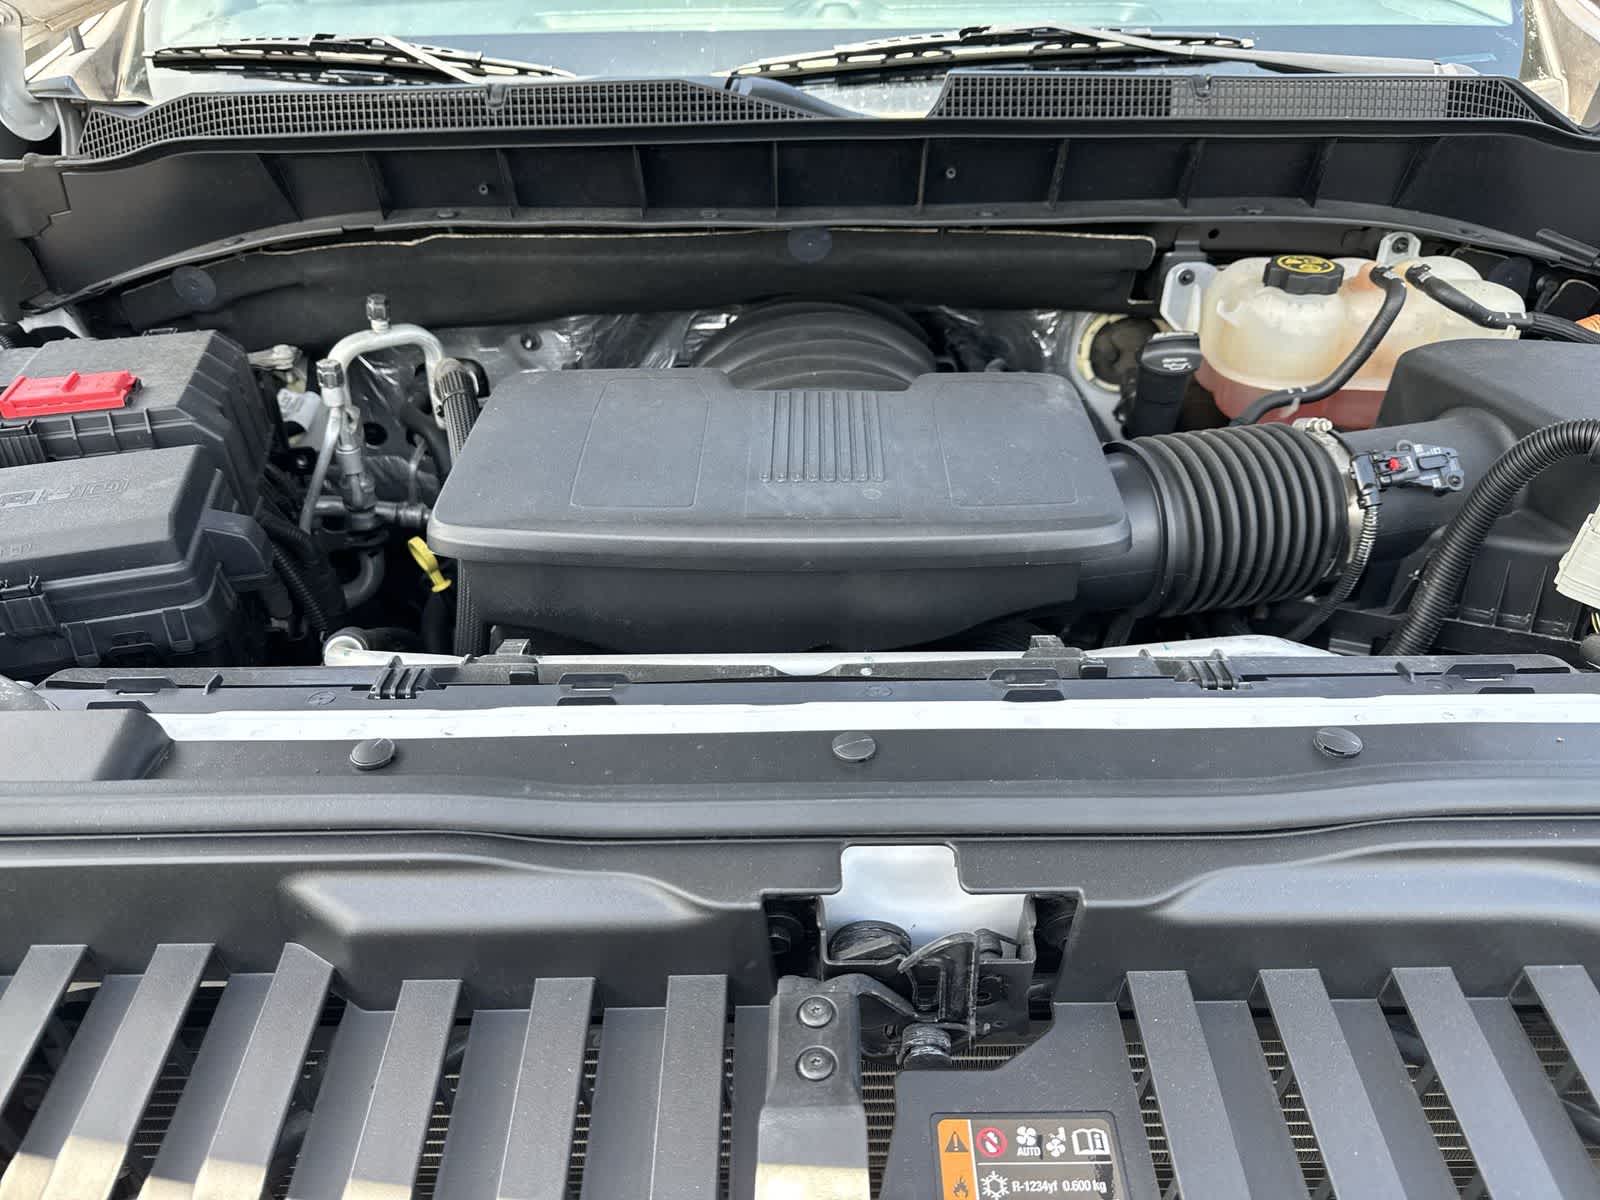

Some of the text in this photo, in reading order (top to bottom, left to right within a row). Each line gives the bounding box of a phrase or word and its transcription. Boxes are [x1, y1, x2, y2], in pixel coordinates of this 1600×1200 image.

[1017, 1146, 1041, 1157] AUTO
[1011, 1179, 1108, 1194] R-1234yf 0.600 kg
